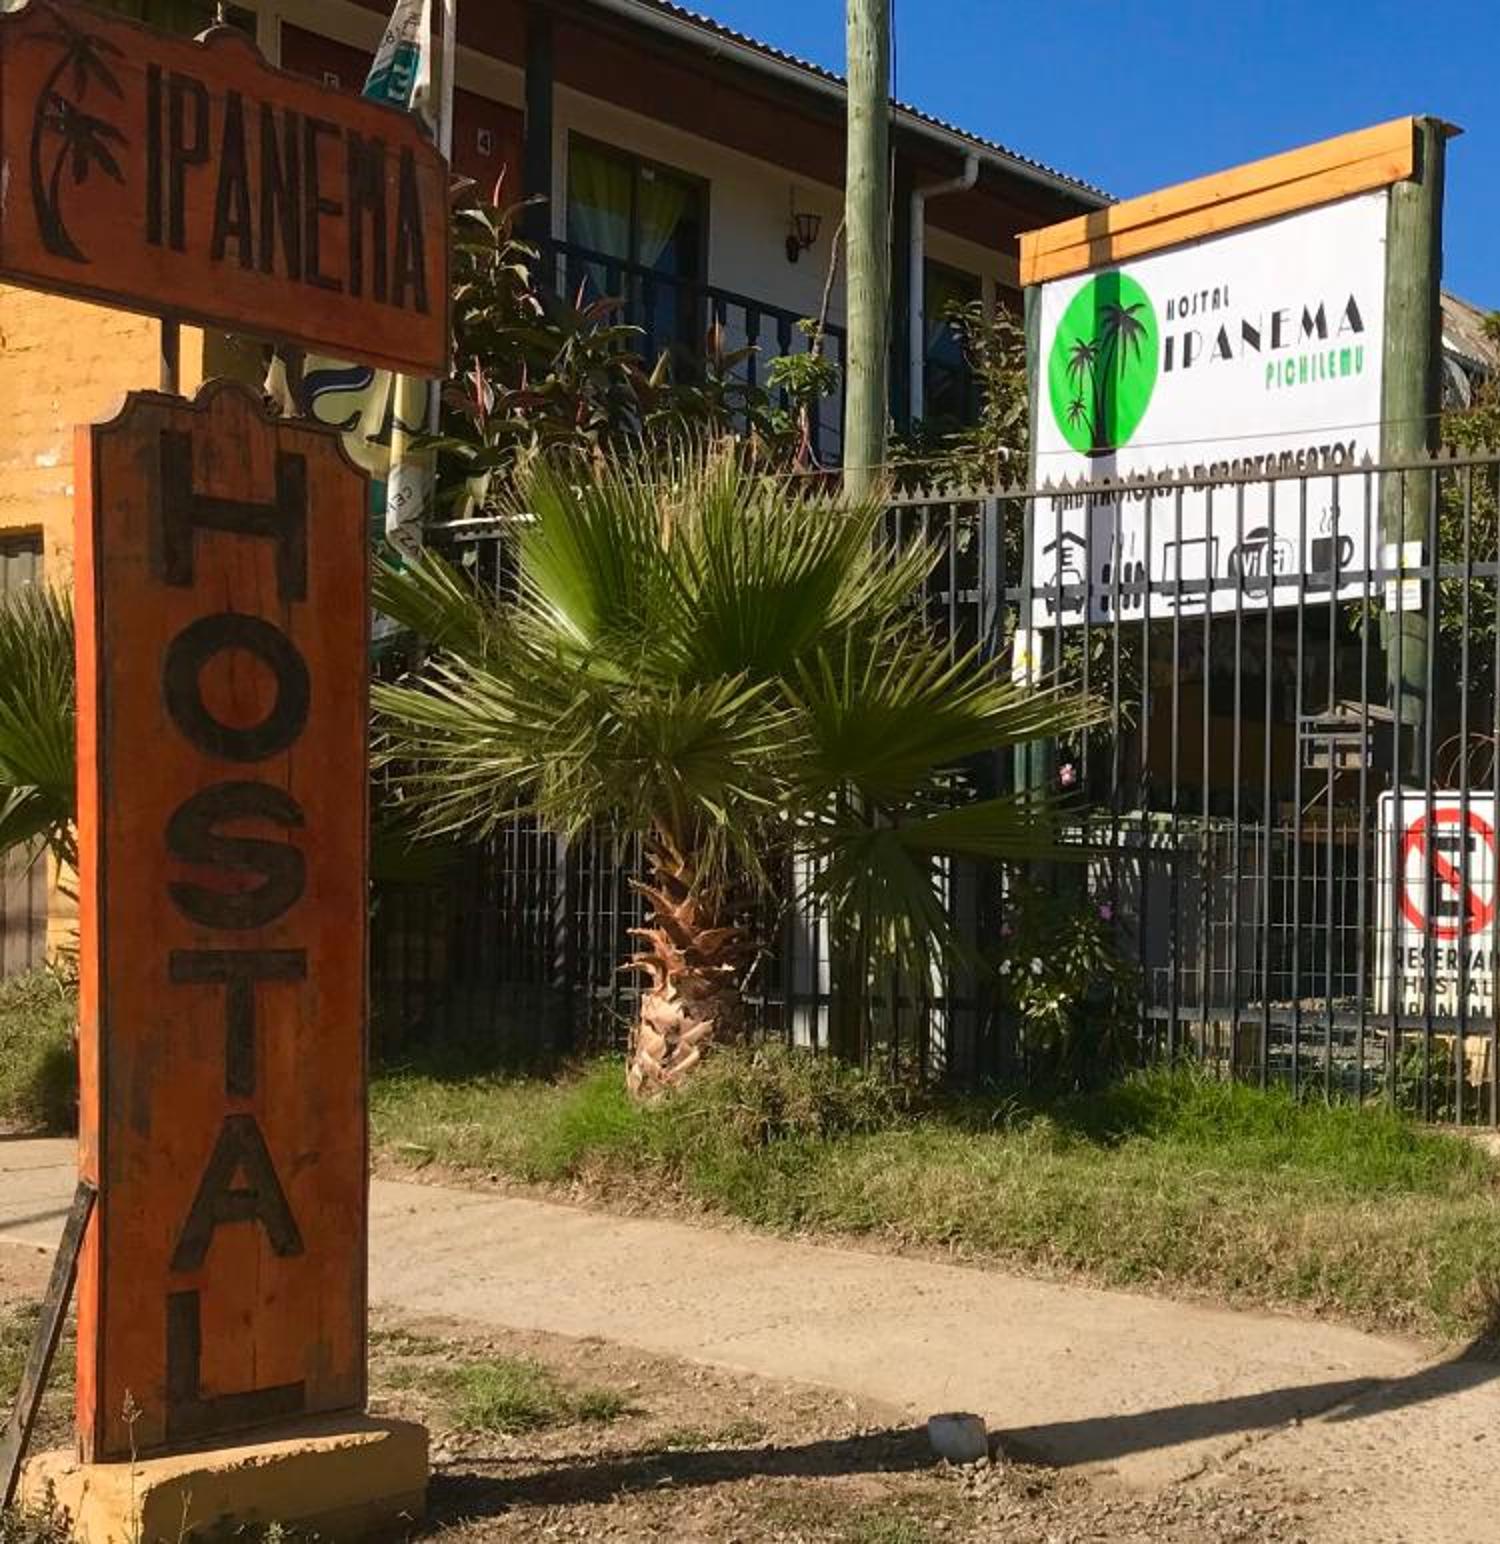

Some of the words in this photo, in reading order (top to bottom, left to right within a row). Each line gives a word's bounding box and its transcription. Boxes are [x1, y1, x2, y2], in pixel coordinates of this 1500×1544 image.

[145, 62, 430, 315] IPANEMA
[1163, 293, 1366, 373] IPANEMA
[1166, 285, 1230, 321] HOSTAL
[1265, 343, 1365, 390] PICHILEMU
[160, 430, 312, 1442] HOSTAL
[1403, 975, 1495, 997] HSTAL
